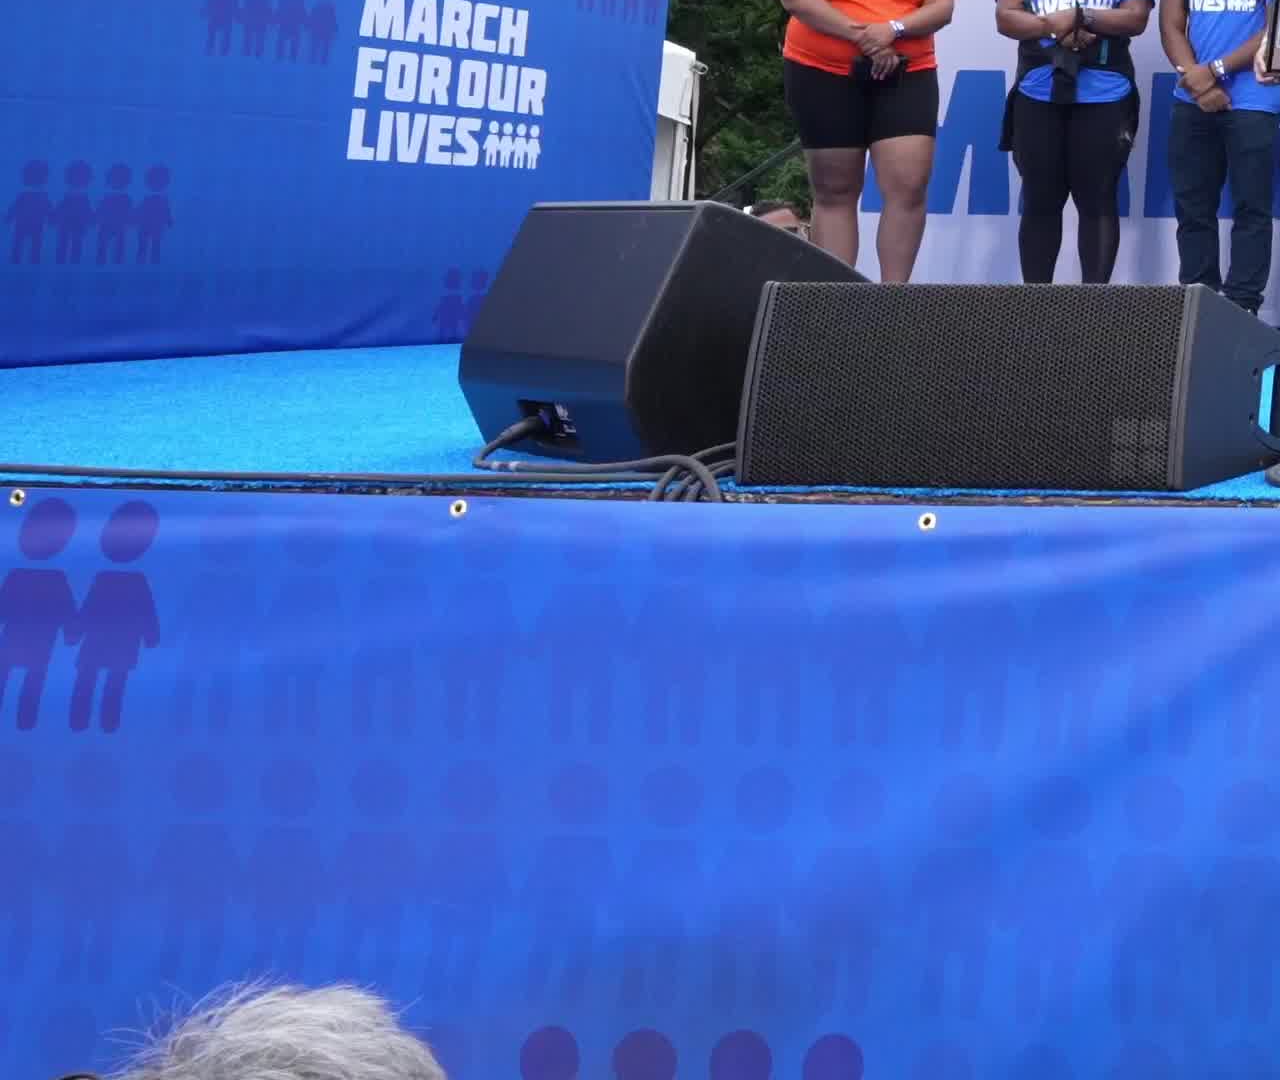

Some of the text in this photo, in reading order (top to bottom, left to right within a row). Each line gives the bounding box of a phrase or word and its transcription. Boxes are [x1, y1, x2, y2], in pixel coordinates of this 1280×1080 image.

[354, 47, 547, 116] FOR OUR
[347, 108, 481, 167] LIVES
